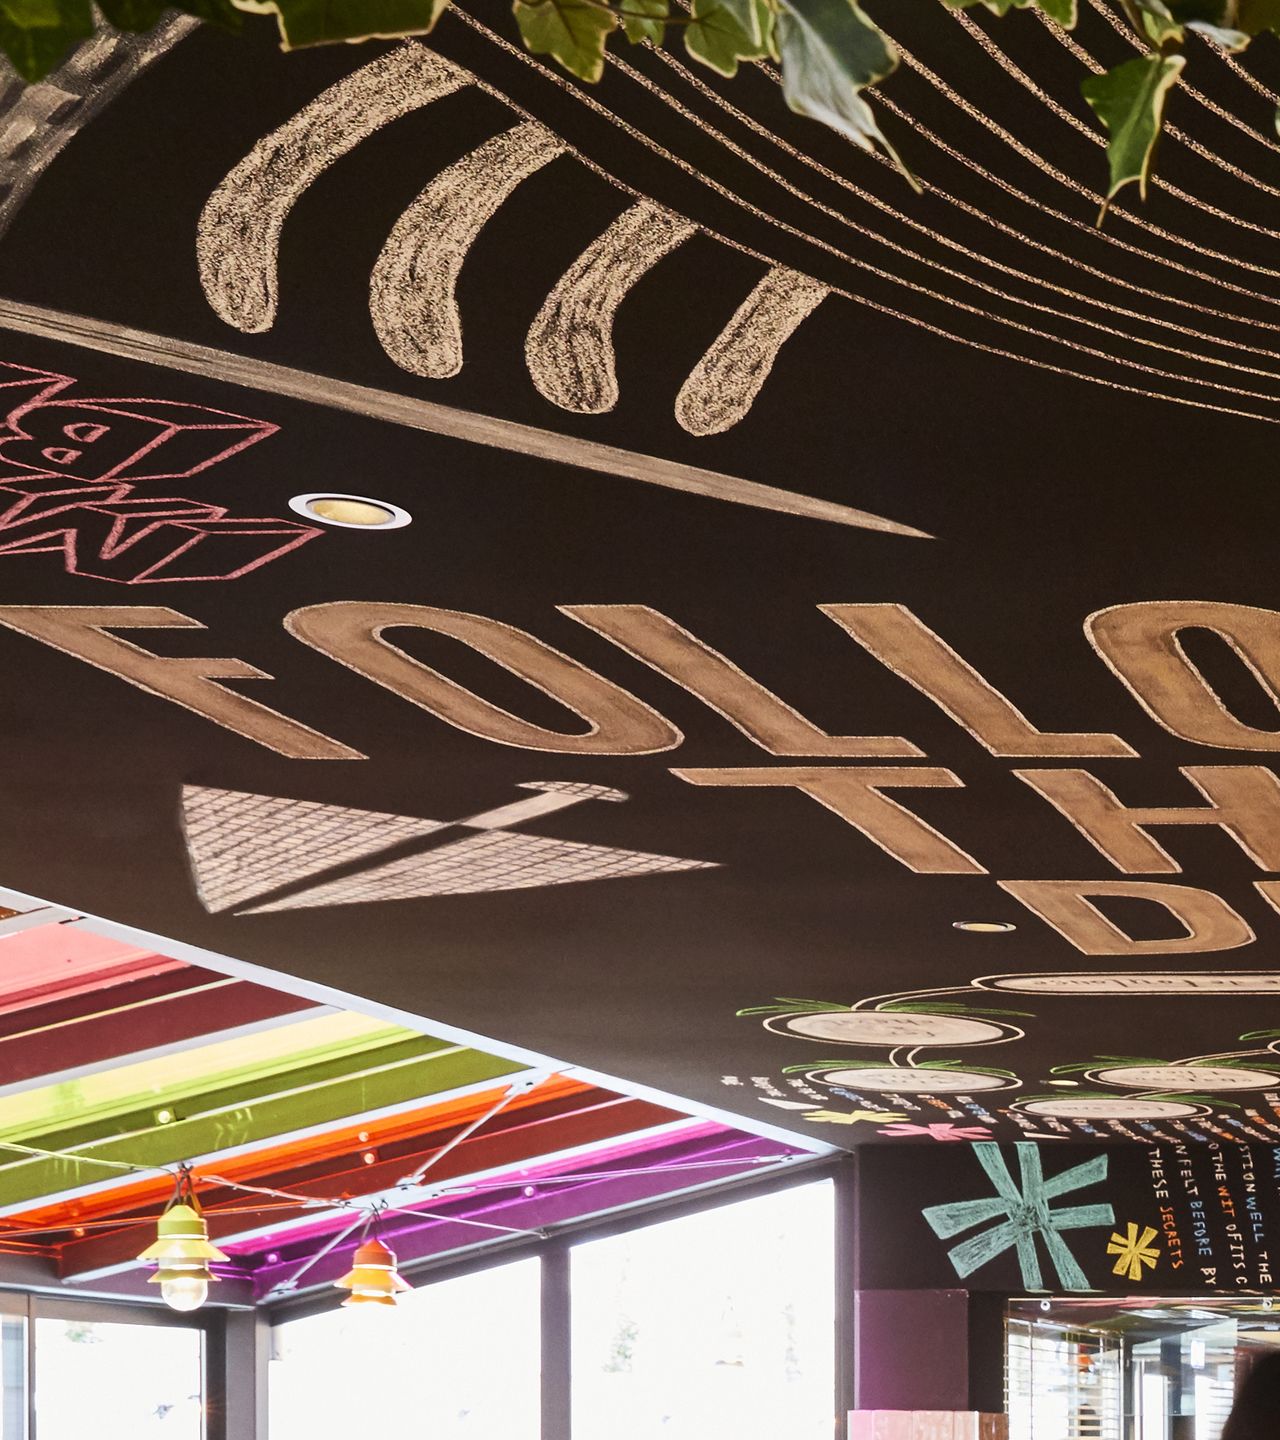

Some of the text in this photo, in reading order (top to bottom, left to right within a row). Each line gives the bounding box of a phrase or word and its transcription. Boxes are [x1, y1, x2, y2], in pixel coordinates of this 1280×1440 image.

[1149, 1148, 1184, 1269] THESE SECRETS
[1178, 1159, 1216, 1284] FELT BEFORE BY
[1212, 1152, 1245, 1269] THE WIT OF ITS
[1246, 1197, 1272, 1284] WELL THE
